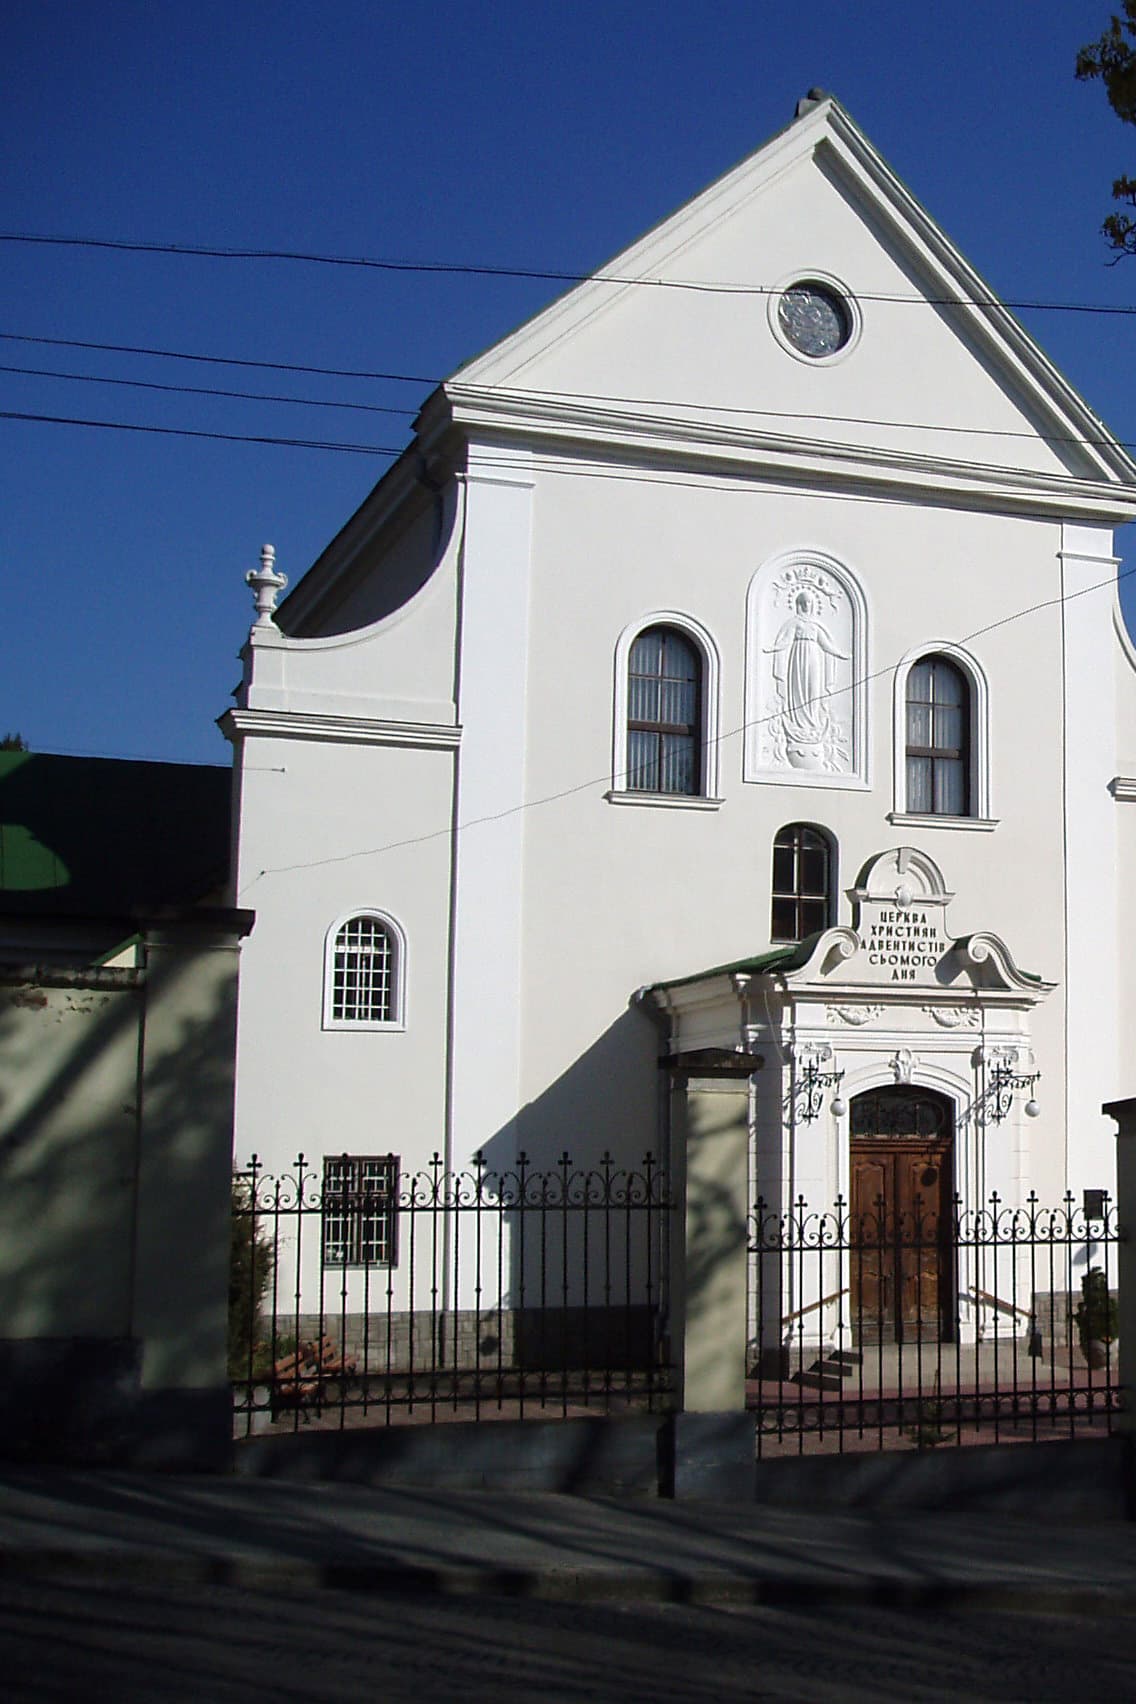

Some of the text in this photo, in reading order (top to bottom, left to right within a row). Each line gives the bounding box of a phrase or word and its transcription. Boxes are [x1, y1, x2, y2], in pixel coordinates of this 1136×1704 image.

[880, 911, 927, 923] ЦЕРКВА
[871, 925, 937, 938] ХРИСТИЯН
[860, 939, 945, 953] АДВЕНТИСТІВ
[869, 954, 937, 967] СЬОМОГО
[891, 969, 916, 981] ДНЯ
